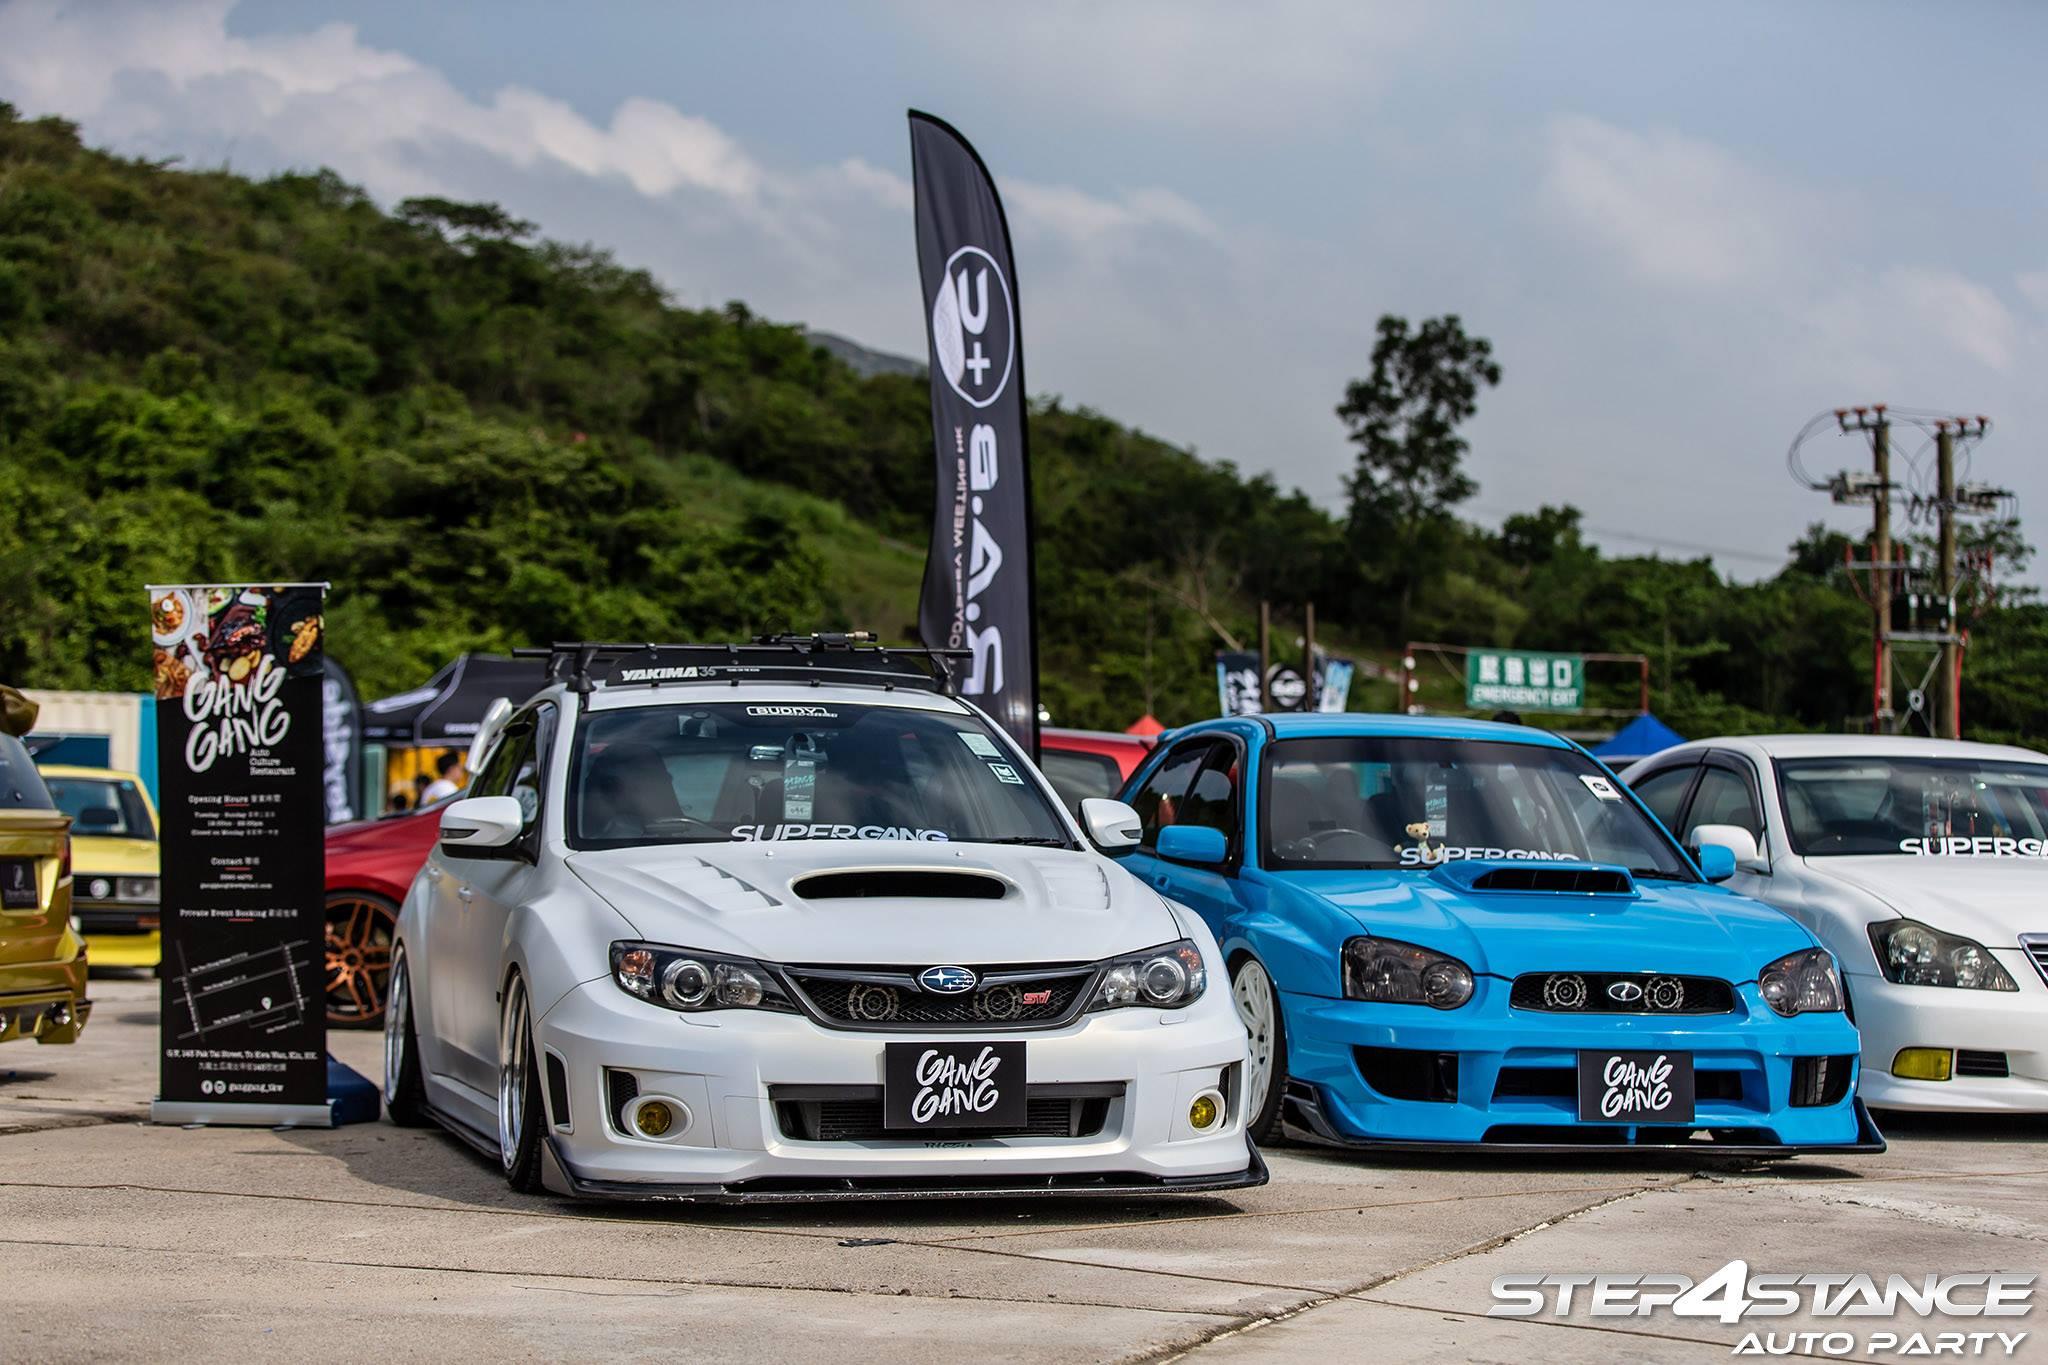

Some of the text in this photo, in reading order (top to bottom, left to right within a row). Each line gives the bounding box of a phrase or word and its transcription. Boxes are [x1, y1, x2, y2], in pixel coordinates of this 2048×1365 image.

[621, 667, 698, 681] YAKIMA
[183, 654, 287, 722] GANG
[1473, 684, 1578, 706] EMERGENCY EXIT
[757, 706, 817, 716] BUDDY
[185, 698, 291, 773] GANG
[250, 749, 271, 757] Auto
[250, 758, 282, 766] Culture
[250, 767, 297, 776] Restaurant
[188, 795, 223, 805] Opening
[224, 795, 249, 804] Hours
[731, 824, 949, 843] SUPERGANG
[211, 857, 243, 866] Contact
[180, 909, 210, 918] Private
[211, 909, 234, 918] Event
[235, 909, 267, 920] Booking
[916, 1046, 1001, 1087] GANG
[1603, 1055, 1673, 1088] GANG
[911, 1079, 999, 1123] GANG
[1601, 1082, 1673, 1118] GANG
